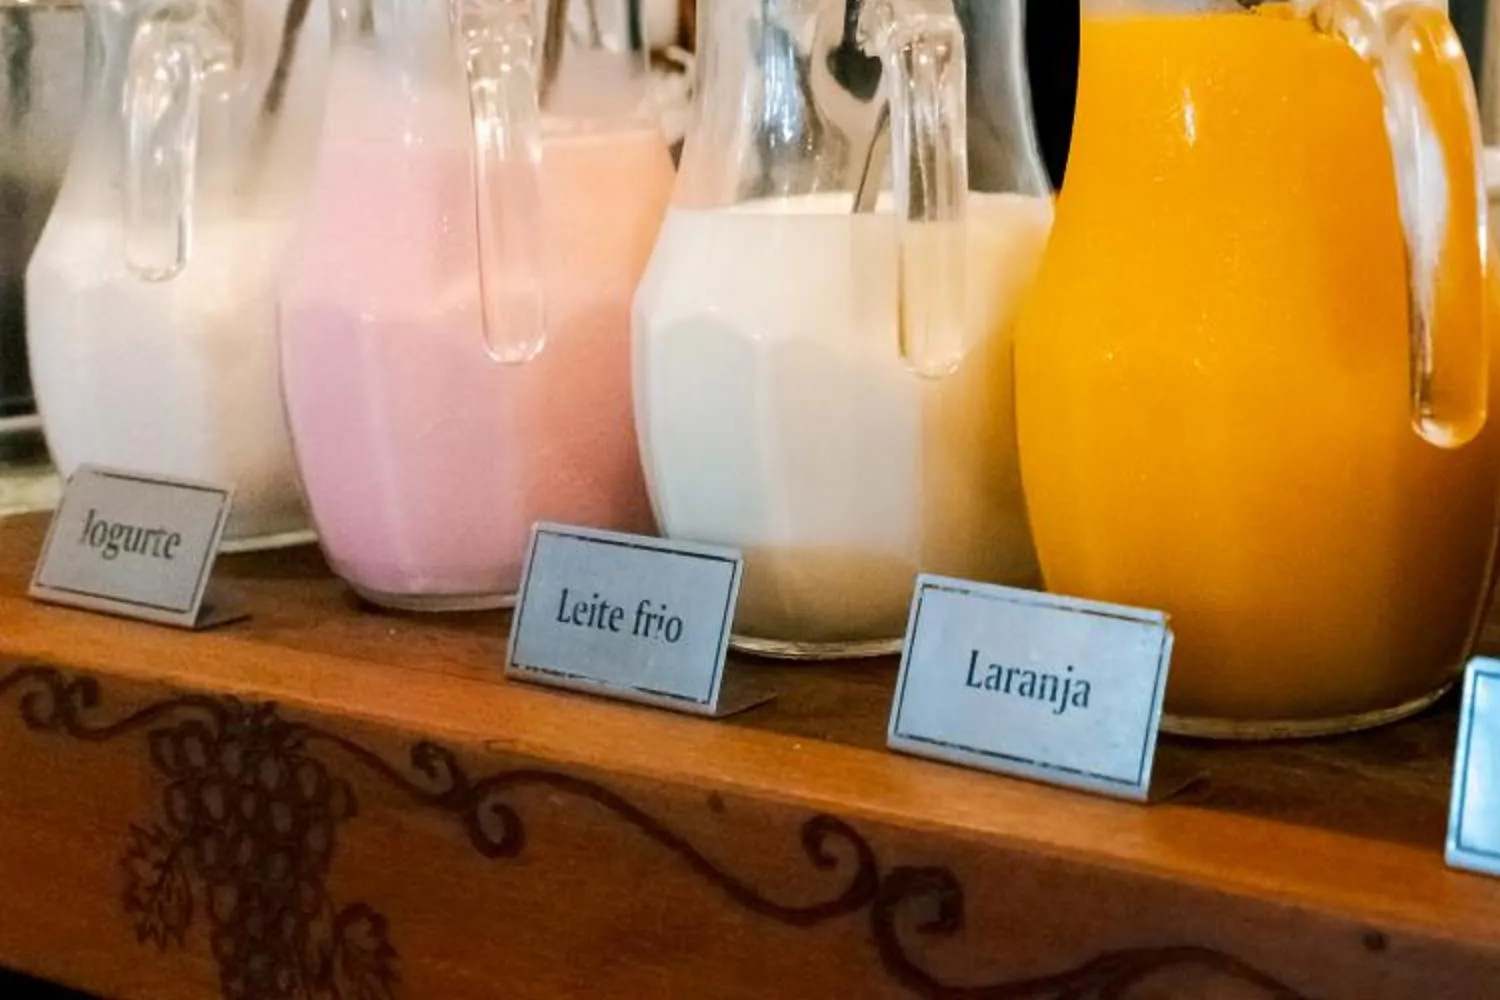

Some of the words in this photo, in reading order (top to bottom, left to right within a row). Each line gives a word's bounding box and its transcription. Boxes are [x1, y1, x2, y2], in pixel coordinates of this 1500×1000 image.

[556, 587, 625, 633] Leite
[632, 599, 684, 644] frio
[965, 648, 1092, 715] Laranja
